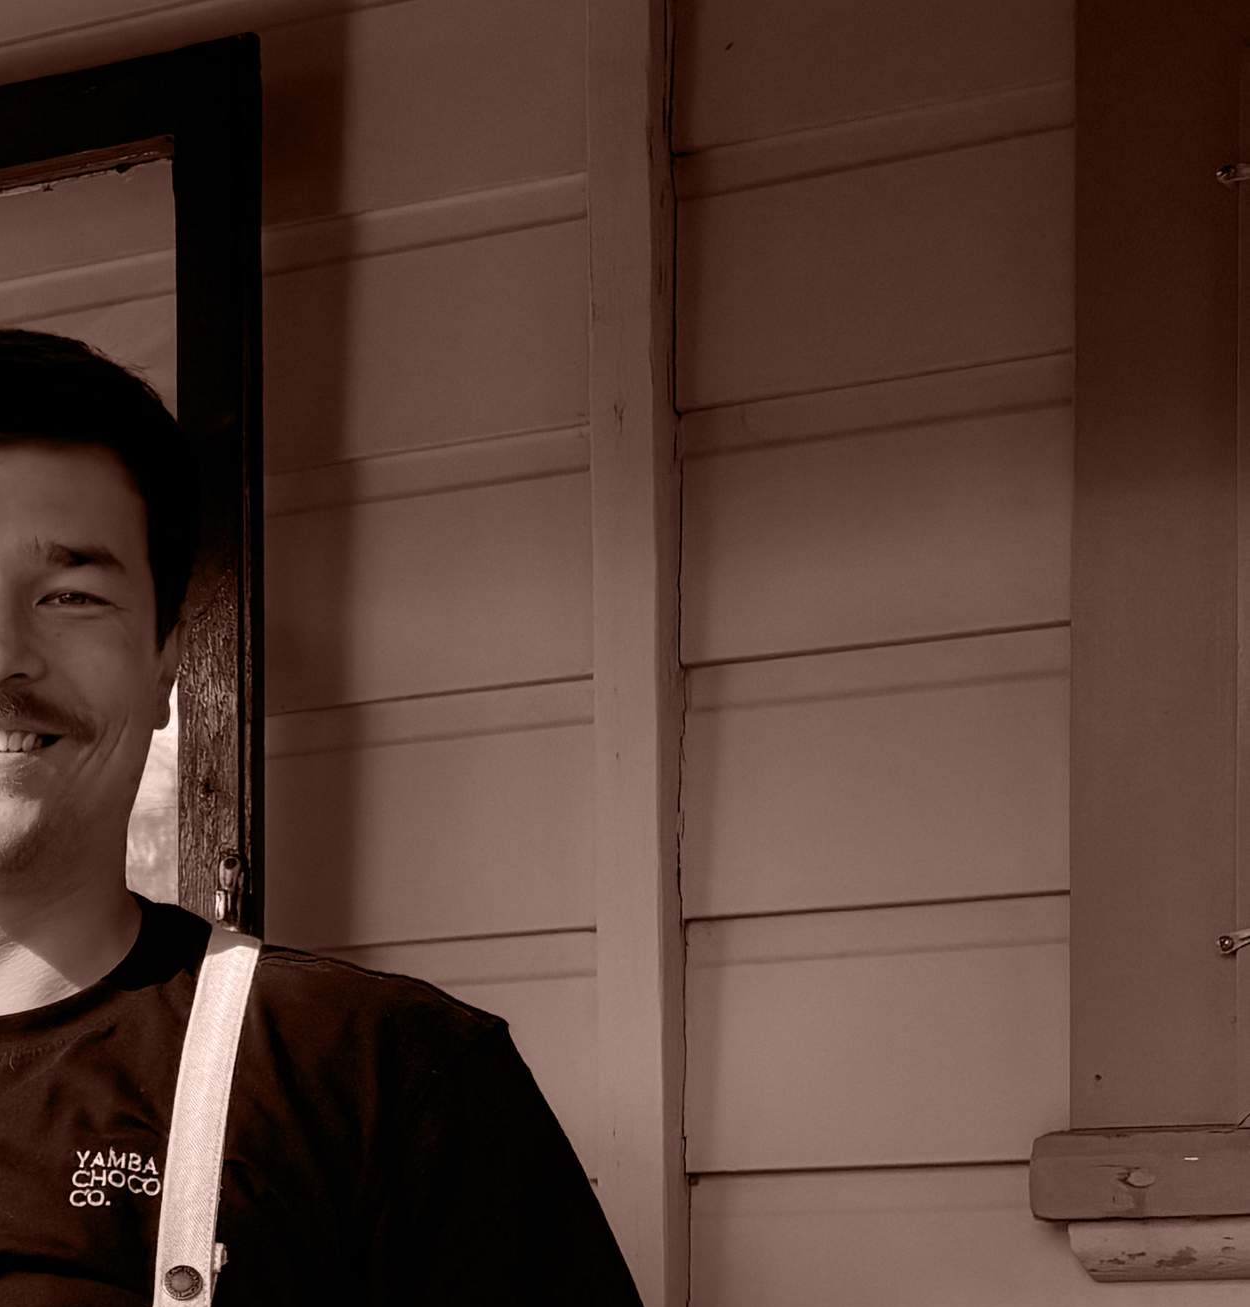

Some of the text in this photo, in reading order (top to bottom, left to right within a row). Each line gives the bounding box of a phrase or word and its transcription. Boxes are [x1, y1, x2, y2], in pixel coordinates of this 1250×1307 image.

[76, 1146, 159, 1175] YAMBA
[71, 1169, 161, 1196] CHOCO
[69, 1188, 111, 1207] CO.
